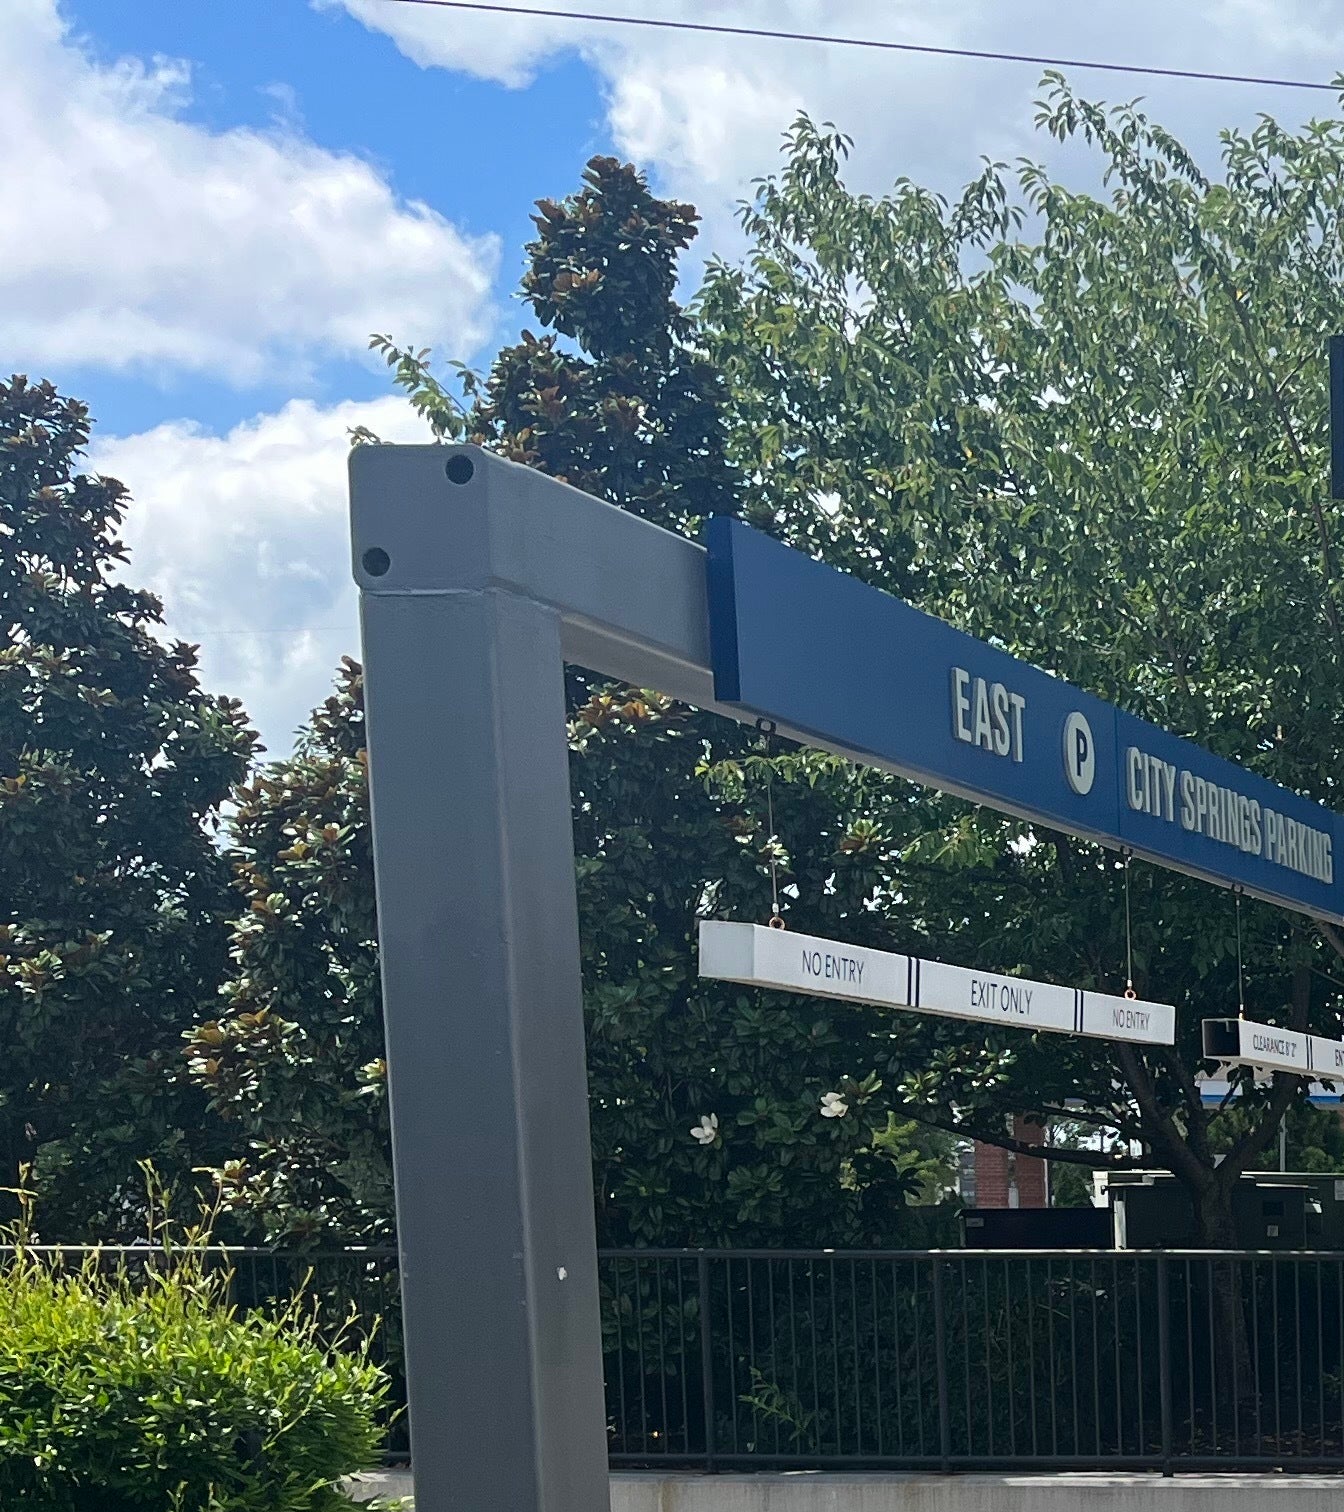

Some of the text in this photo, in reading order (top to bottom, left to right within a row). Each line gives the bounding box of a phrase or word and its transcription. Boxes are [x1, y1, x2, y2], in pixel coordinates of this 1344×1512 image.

[951, 666, 1089, 777] EAST P
[1126, 746, 1176, 822] CITY
[1180, 770, 1261, 856] SPRINGS
[1264, 807, 1333, 885] PARKING
[802, 950, 865, 984] NO ENTRY
[970, 979, 1034, 1015] EXIT ONLY
[1112, 1008, 1150, 1031] NO ENTRY
